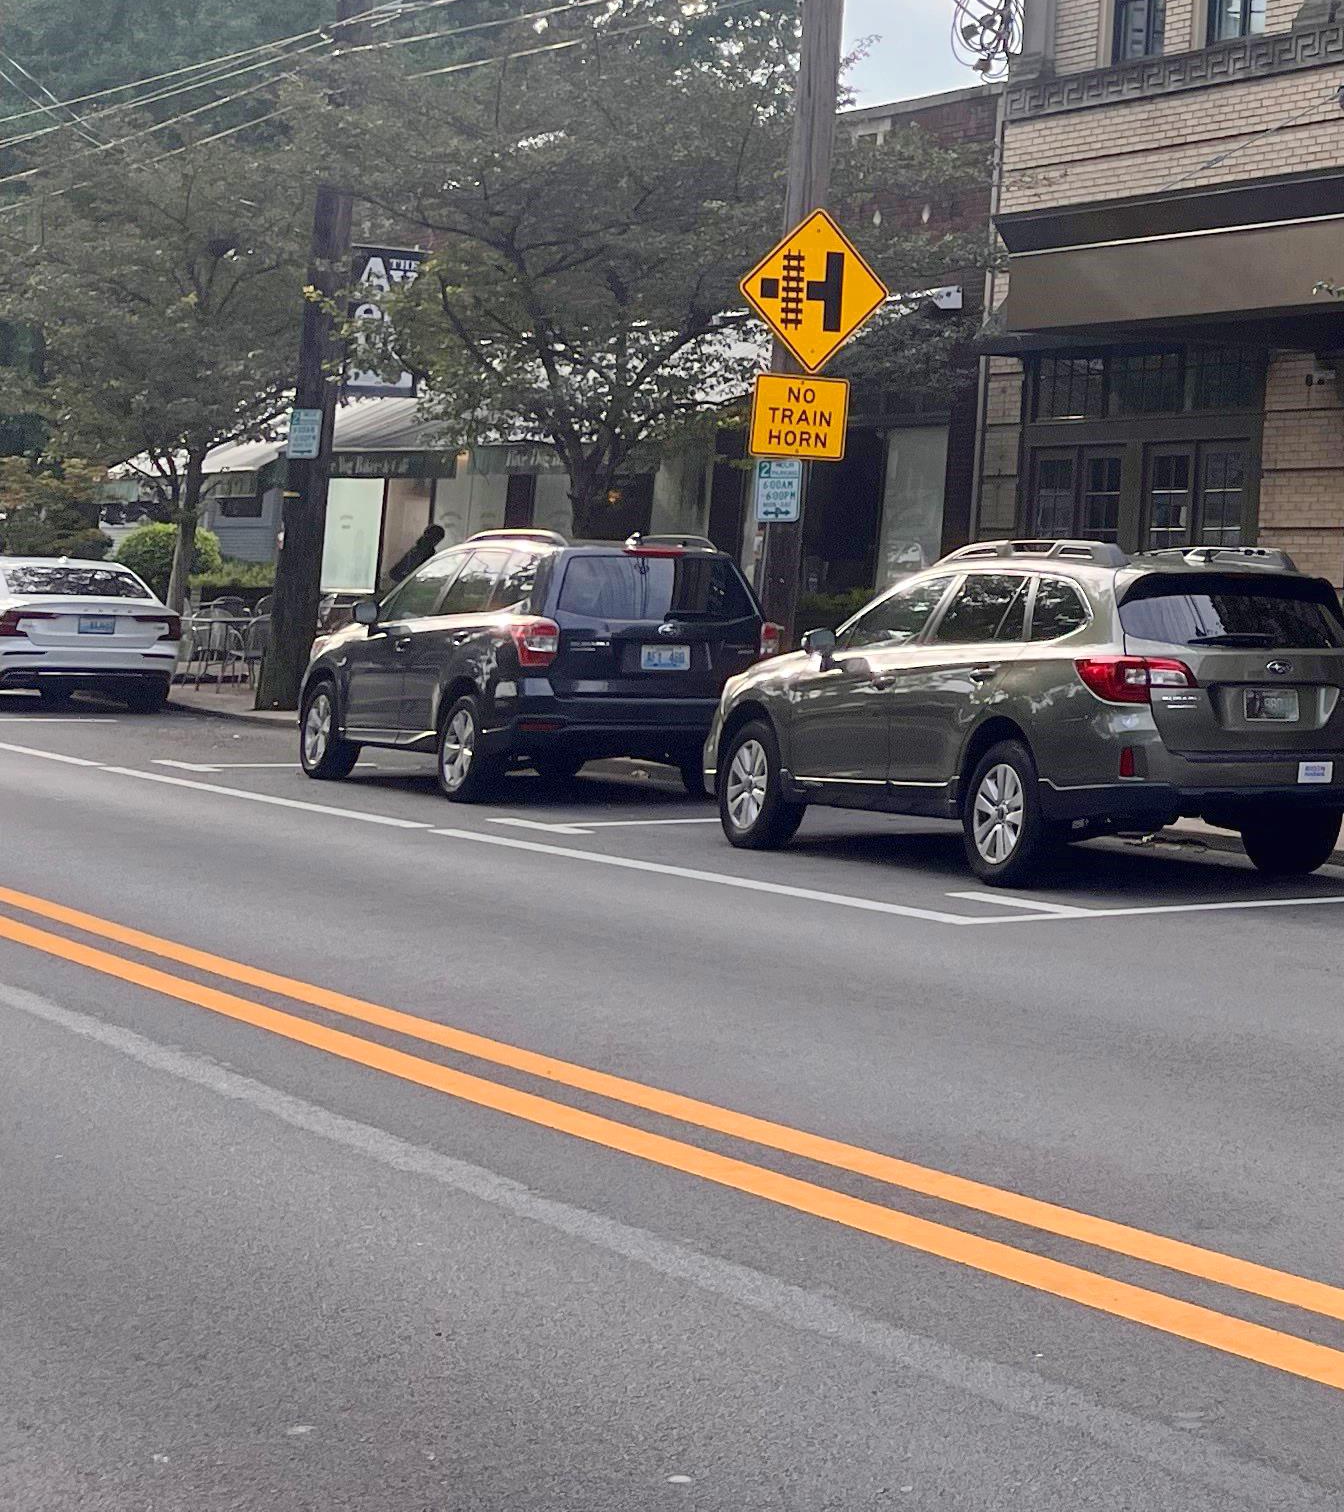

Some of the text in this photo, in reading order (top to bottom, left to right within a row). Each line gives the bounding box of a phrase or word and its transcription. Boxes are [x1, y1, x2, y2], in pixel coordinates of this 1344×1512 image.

[389, 258, 421, 270] THE
[787, 386, 816, 405] NO
[768, 406, 832, 427] TRAIN
[768, 428, 828, 449] HORN
[760, 462, 771, 478] 2
